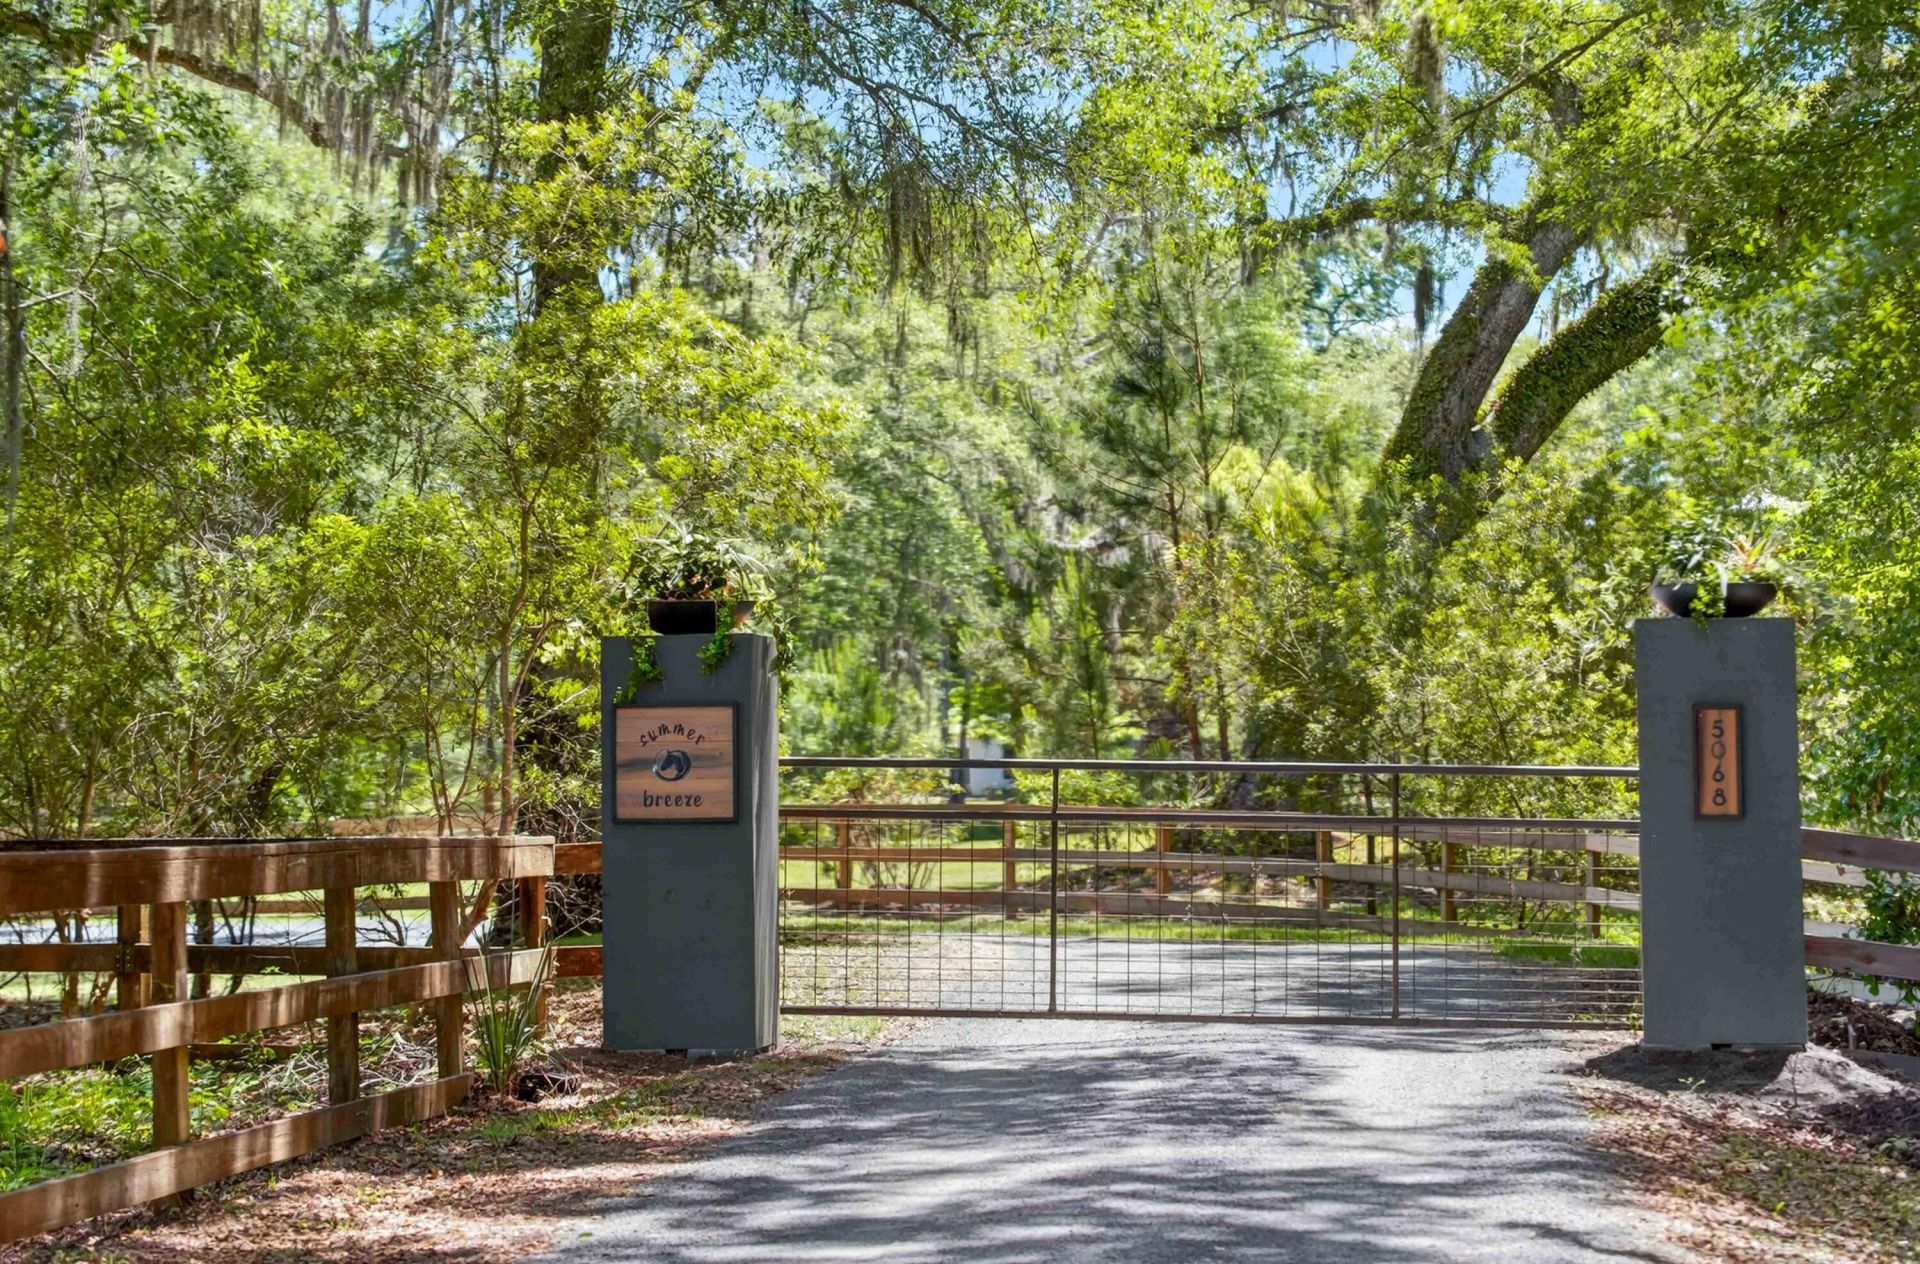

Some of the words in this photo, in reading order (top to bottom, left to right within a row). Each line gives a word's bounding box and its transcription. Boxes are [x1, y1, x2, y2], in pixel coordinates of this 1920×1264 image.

[640, 723, 705, 747] summer
[1711, 719, 1726, 806] 5068
[642, 789, 703, 808] breeze
